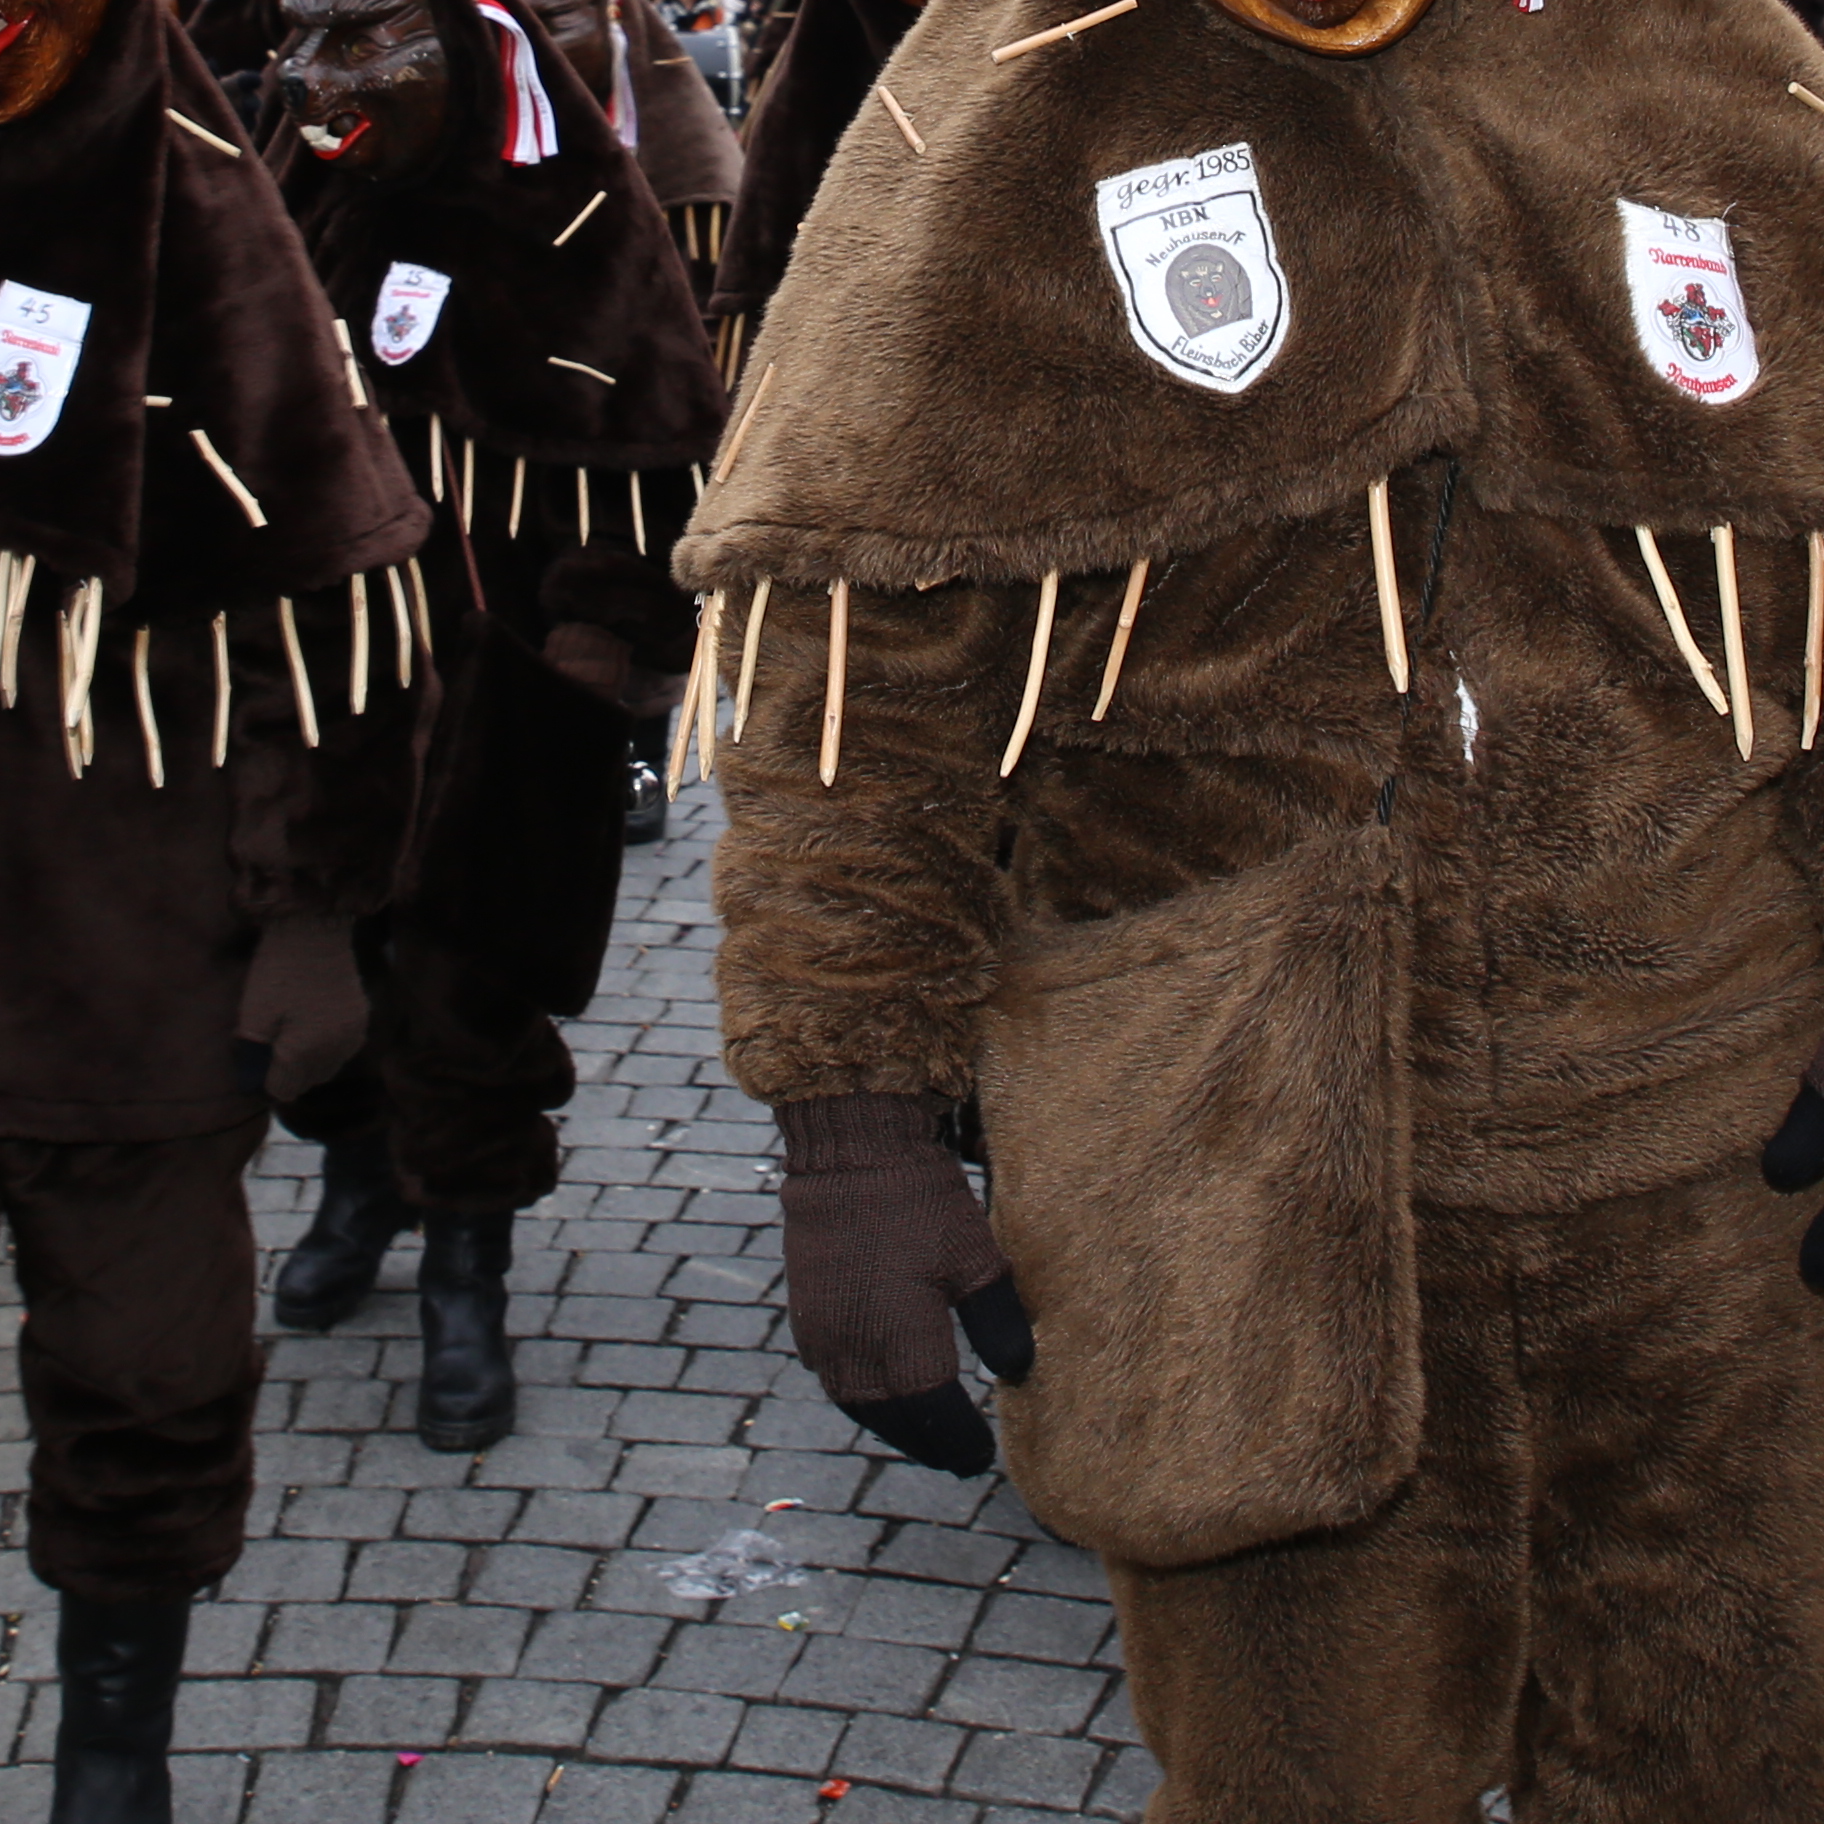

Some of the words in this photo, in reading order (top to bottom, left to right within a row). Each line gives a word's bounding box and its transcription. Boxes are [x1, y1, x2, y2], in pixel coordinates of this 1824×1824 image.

[1117, 167, 1190, 210] gegr.
[1194, 148, 1251, 181] 1985
[1160, 206, 1210, 232] NBN
[1662, 213, 1701, 243] 48
[1648, 247, 1728, 276] Narrenbund
[19, 297, 55, 324] 45
[1170, 335, 1247, 371] Fleinsbach
[1238, 319, 1270, 354] Biber
[1665, 361, 1739, 396] Neuhausen
